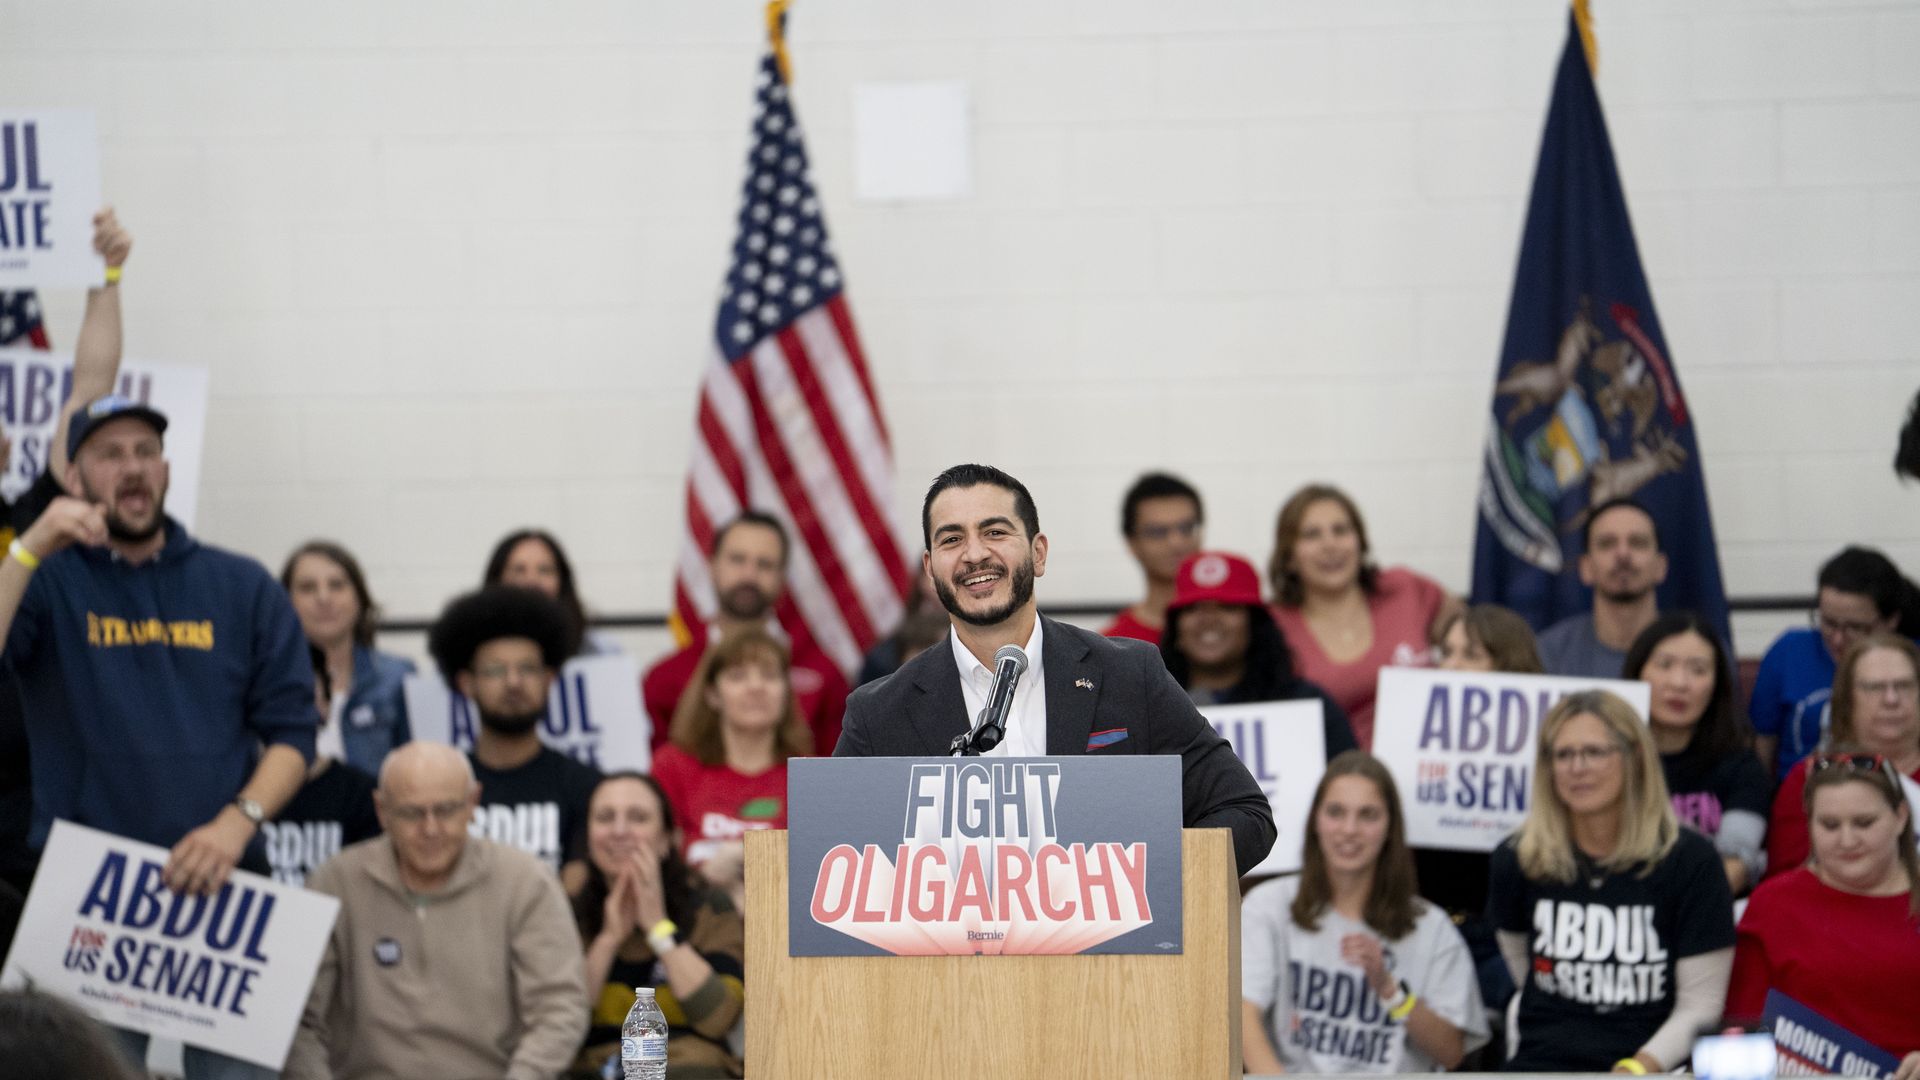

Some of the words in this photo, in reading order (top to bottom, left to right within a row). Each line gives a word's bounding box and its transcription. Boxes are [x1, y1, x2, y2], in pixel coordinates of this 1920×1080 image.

[904, 764, 1060, 839] FIGHT
[78, 850, 277, 963] ABDUL
[810, 843, 1153, 924] OLIGARCHY
[967, 930, 1004, 941] Bernie
[1533, 898, 1668, 965] ABDUL
[64, 948, 101, 974] US
[105, 936, 261, 1017] SENATE
[1554, 960, 1668, 1005] SENATE
[1774, 1015, 1840, 1070] MONEY
